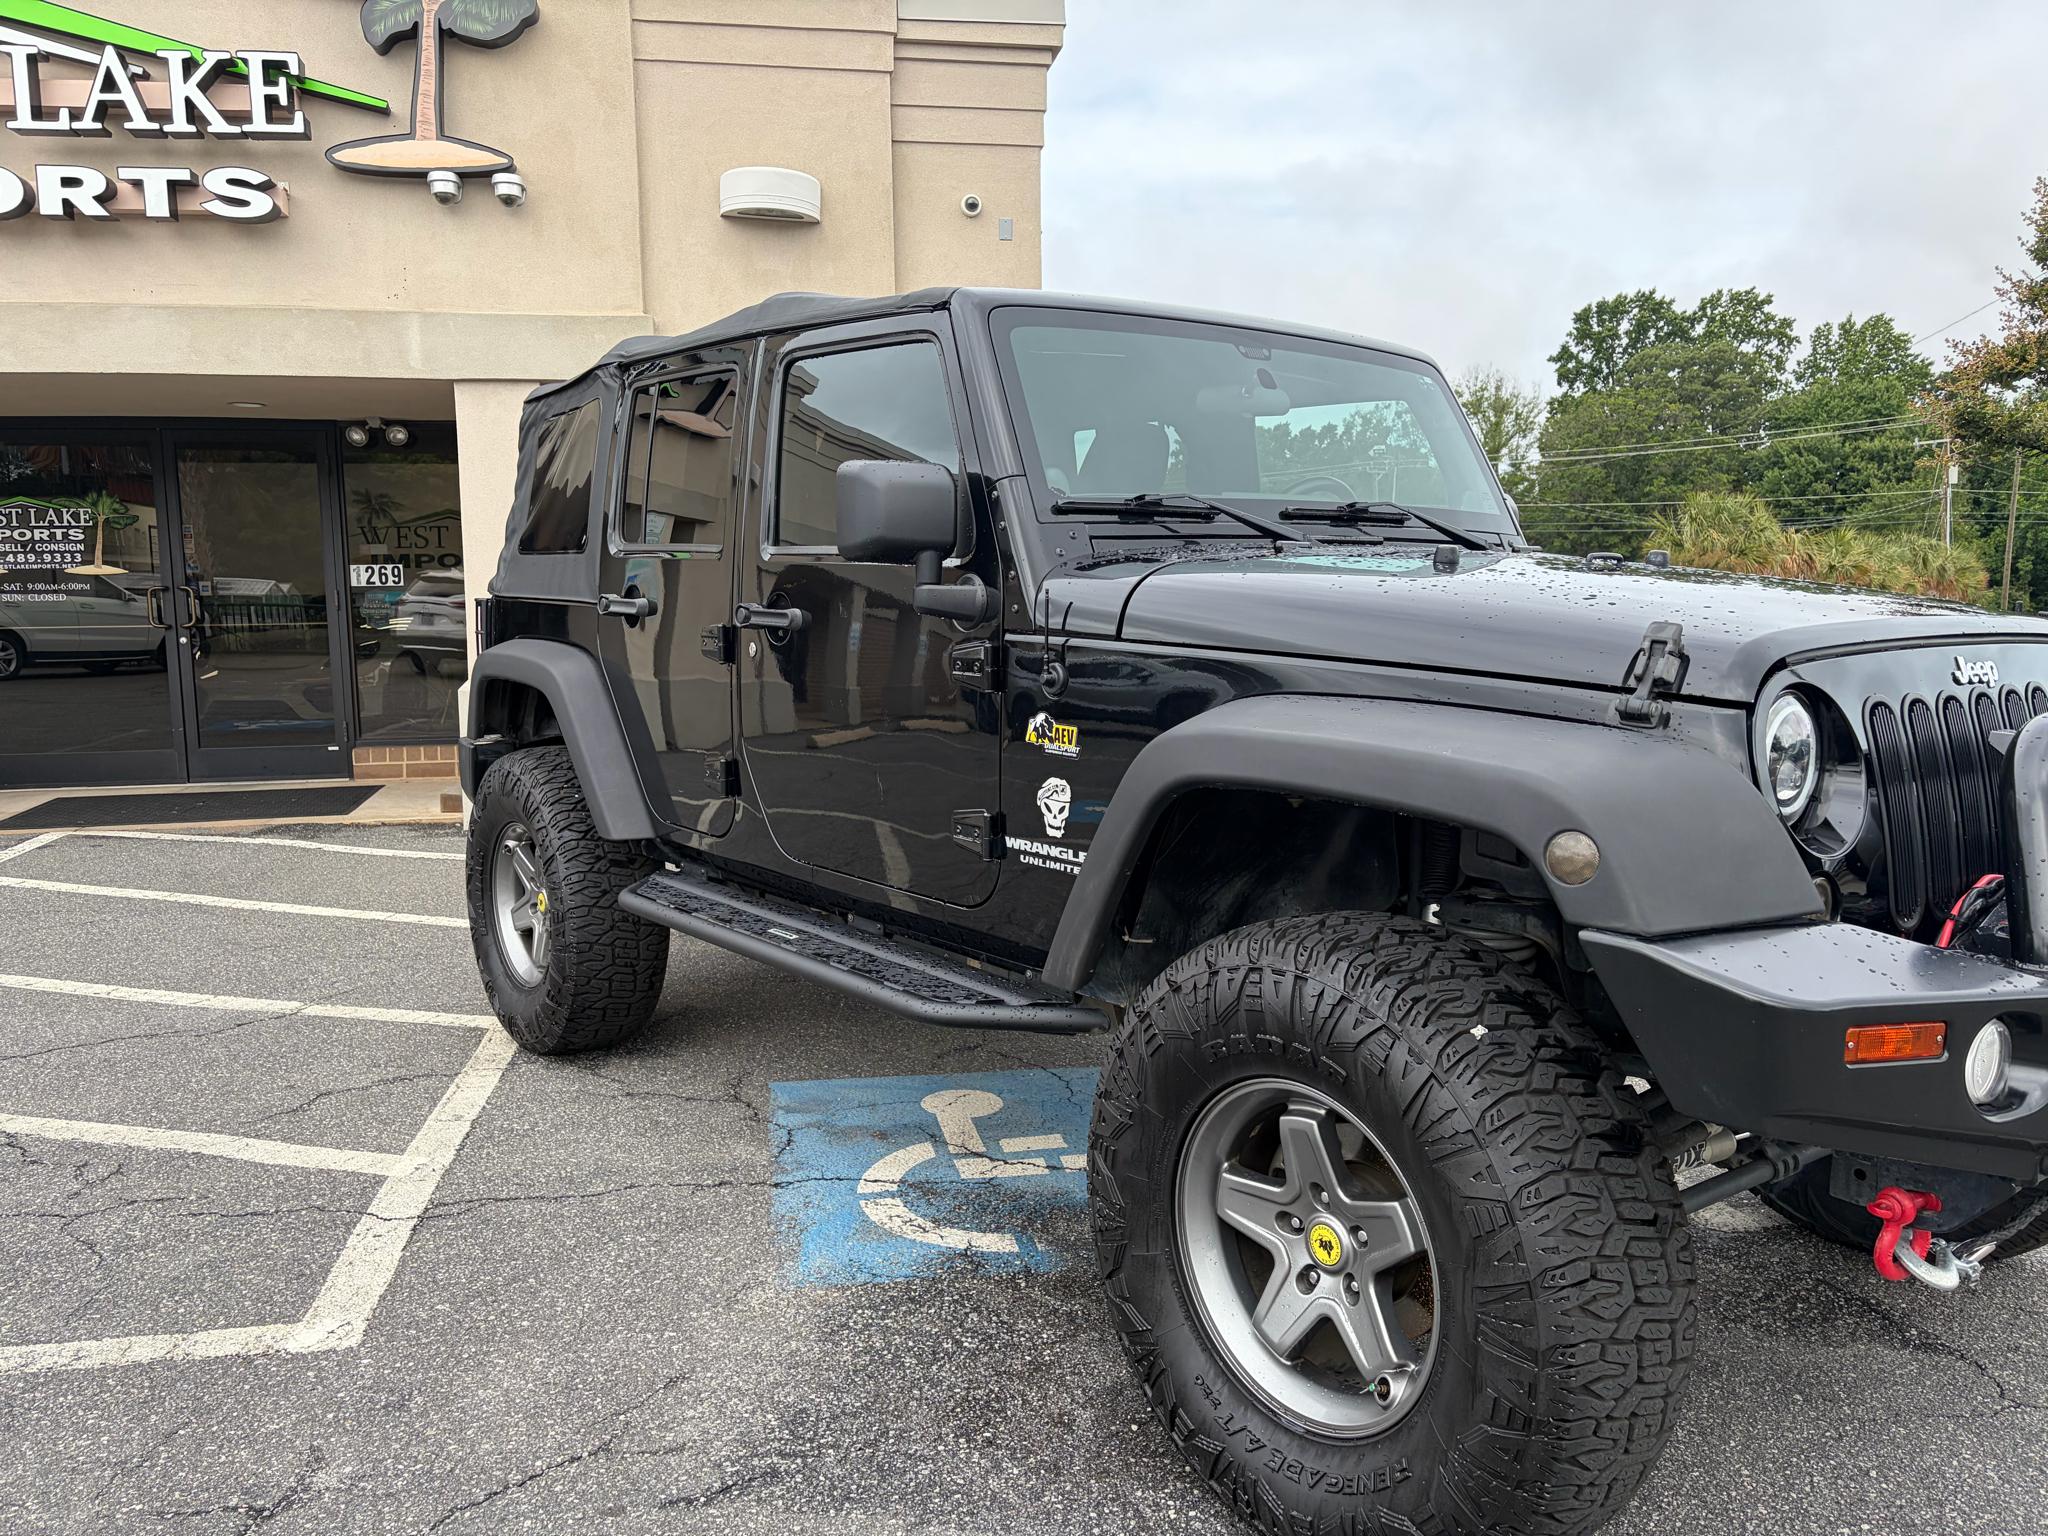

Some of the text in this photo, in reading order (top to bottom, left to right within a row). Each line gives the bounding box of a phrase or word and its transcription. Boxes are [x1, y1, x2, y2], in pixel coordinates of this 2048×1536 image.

[2, 45, 308, 138] LAKE
[28, 508, 93, 527] LAKE
[35, 543, 85, 552] CONSIGN
[357, 525, 449, 549] WEST
[352, 565, 402, 586] 1269
[27, 582, 90, 591] 9:00AM-6:00PM
[1, 593, 67, 602] SUN: CLOSED
[1952, 655, 1999, 688] Jeep
[1054, 726, 1075, 746] AEV
[1005, 835, 1087, 863] WRANGLE
[1020, 854, 1081, 874] UNLIMITE
[1213, 1411, 1268, 1454] A/T
[1264, 1448, 1413, 1496] RENEGADE
